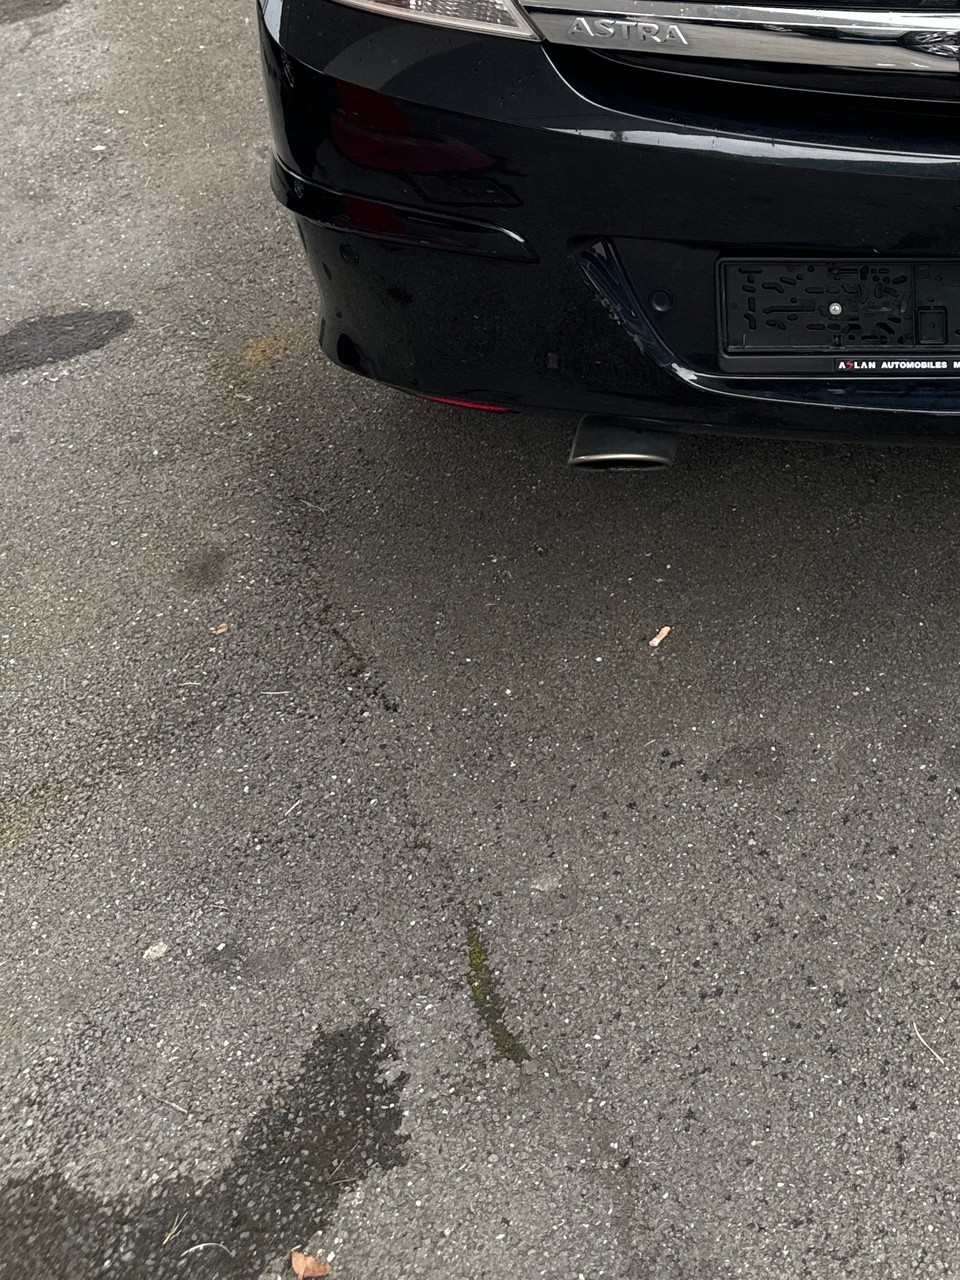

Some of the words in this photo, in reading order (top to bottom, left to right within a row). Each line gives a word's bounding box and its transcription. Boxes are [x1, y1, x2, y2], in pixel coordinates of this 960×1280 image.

[568, 17, 688, 45] ASTRA
[838, 361, 876, 371] ASLAN
[881, 361, 948, 369] AUTOMOBILES
